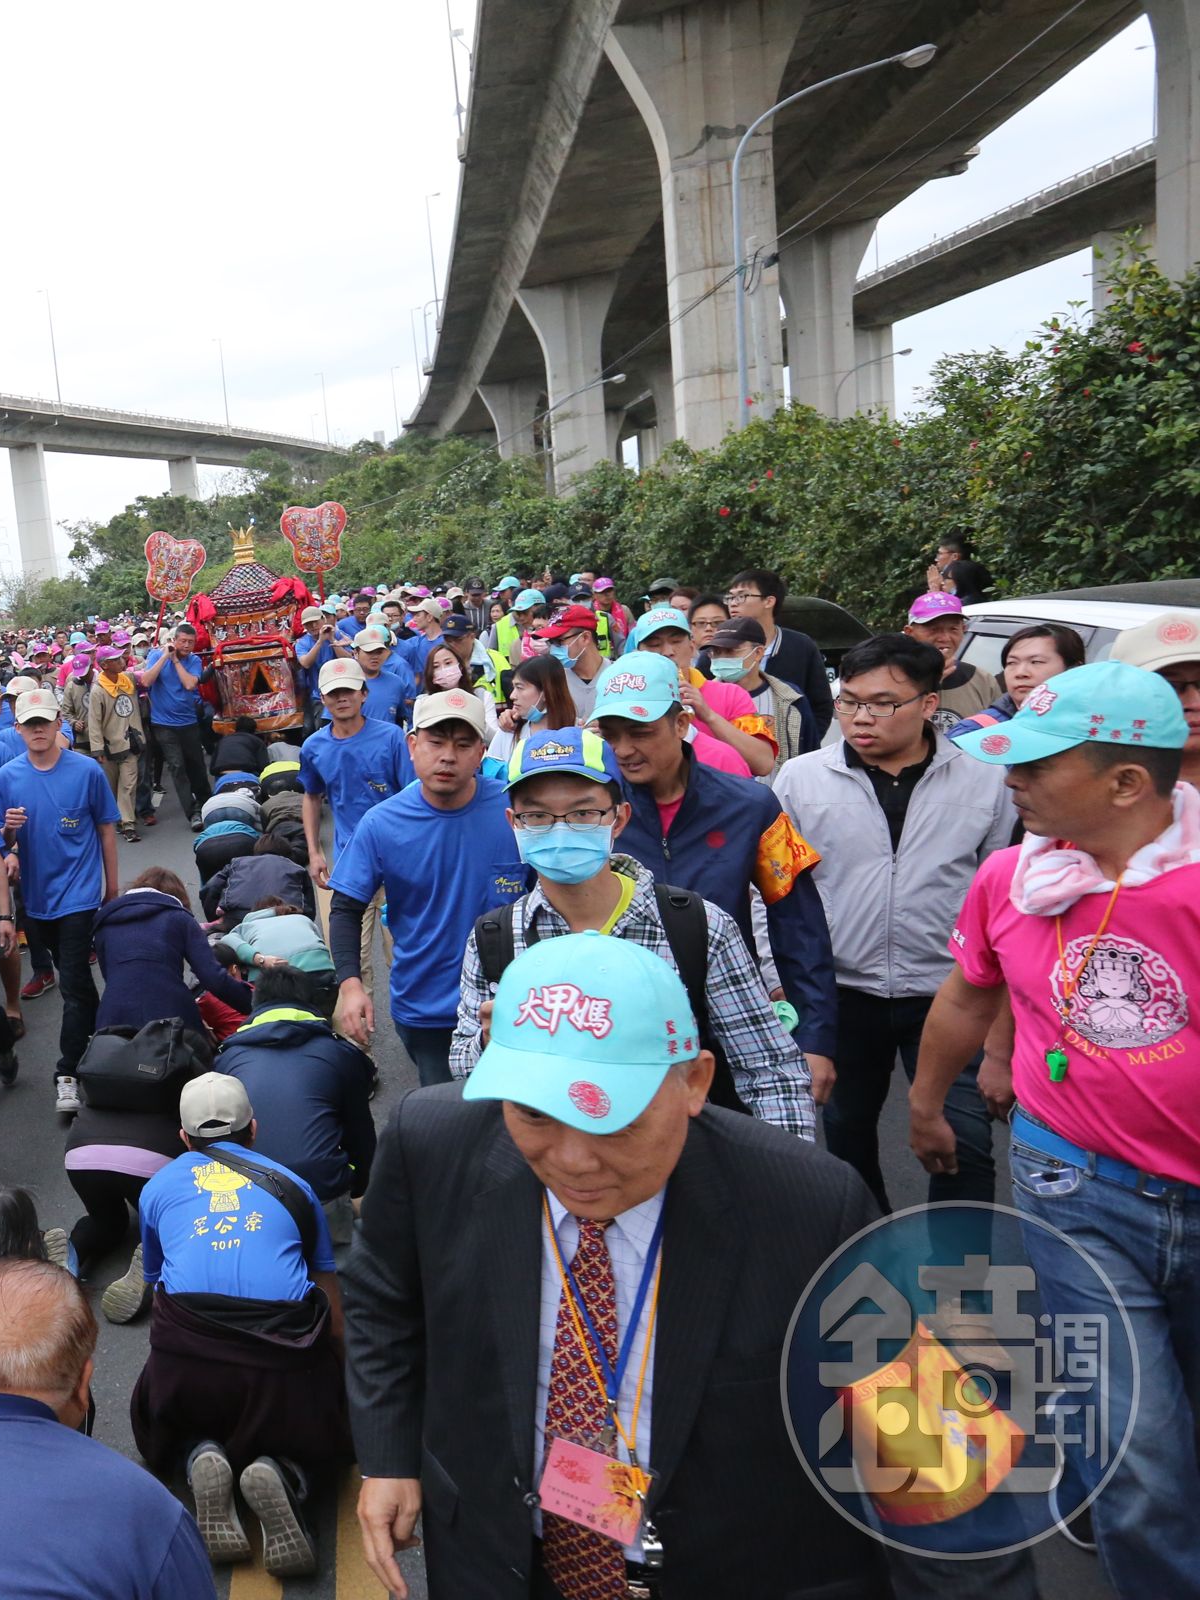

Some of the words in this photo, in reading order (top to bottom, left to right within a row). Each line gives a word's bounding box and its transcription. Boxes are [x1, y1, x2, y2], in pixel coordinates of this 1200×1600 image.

[604, 672, 647, 696] 大甲媽
[513, 983, 613, 1039] 大甲媽
[1126, 1040, 1187, 1067] MAZU
[211, 1238, 241, 1251] 2017
